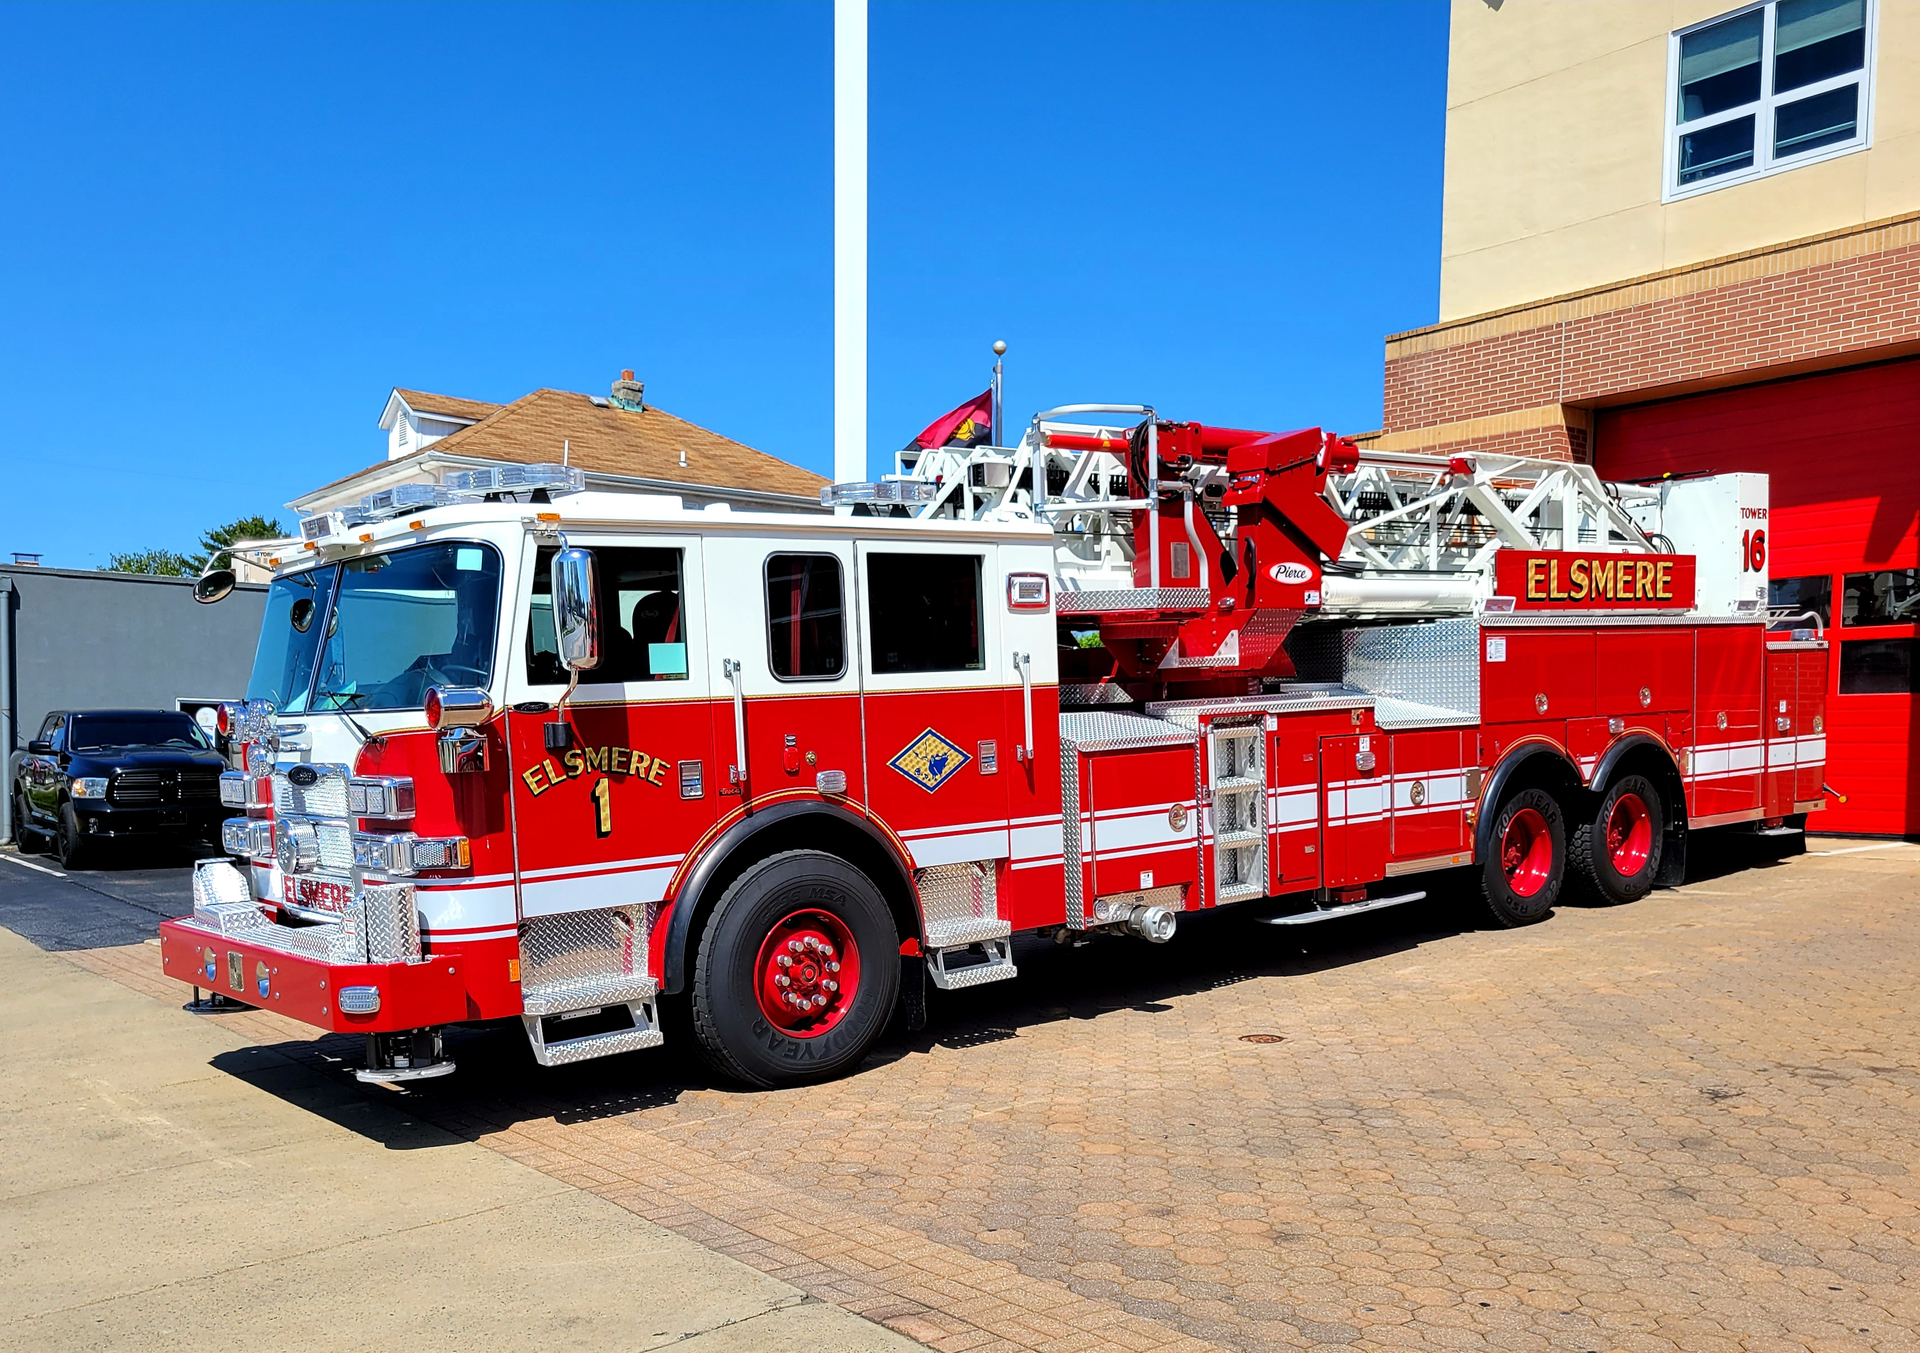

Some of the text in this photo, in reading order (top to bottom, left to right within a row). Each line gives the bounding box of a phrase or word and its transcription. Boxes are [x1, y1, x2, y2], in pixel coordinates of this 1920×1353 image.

[1741, 507, 1767, 520] TOWER
[1275, 564, 1307, 579] Pierce
[1742, 529, 1766, 573] 16
[1526, 558, 1674, 602] ELSMERE
[522, 746, 671, 797] ELSMERE
[590, 777, 612, 839] 1
[284, 875, 352, 913] ELSMERE
[808, 887, 847, 907] MSA
[751, 986, 877, 1062] GOODYEAR
